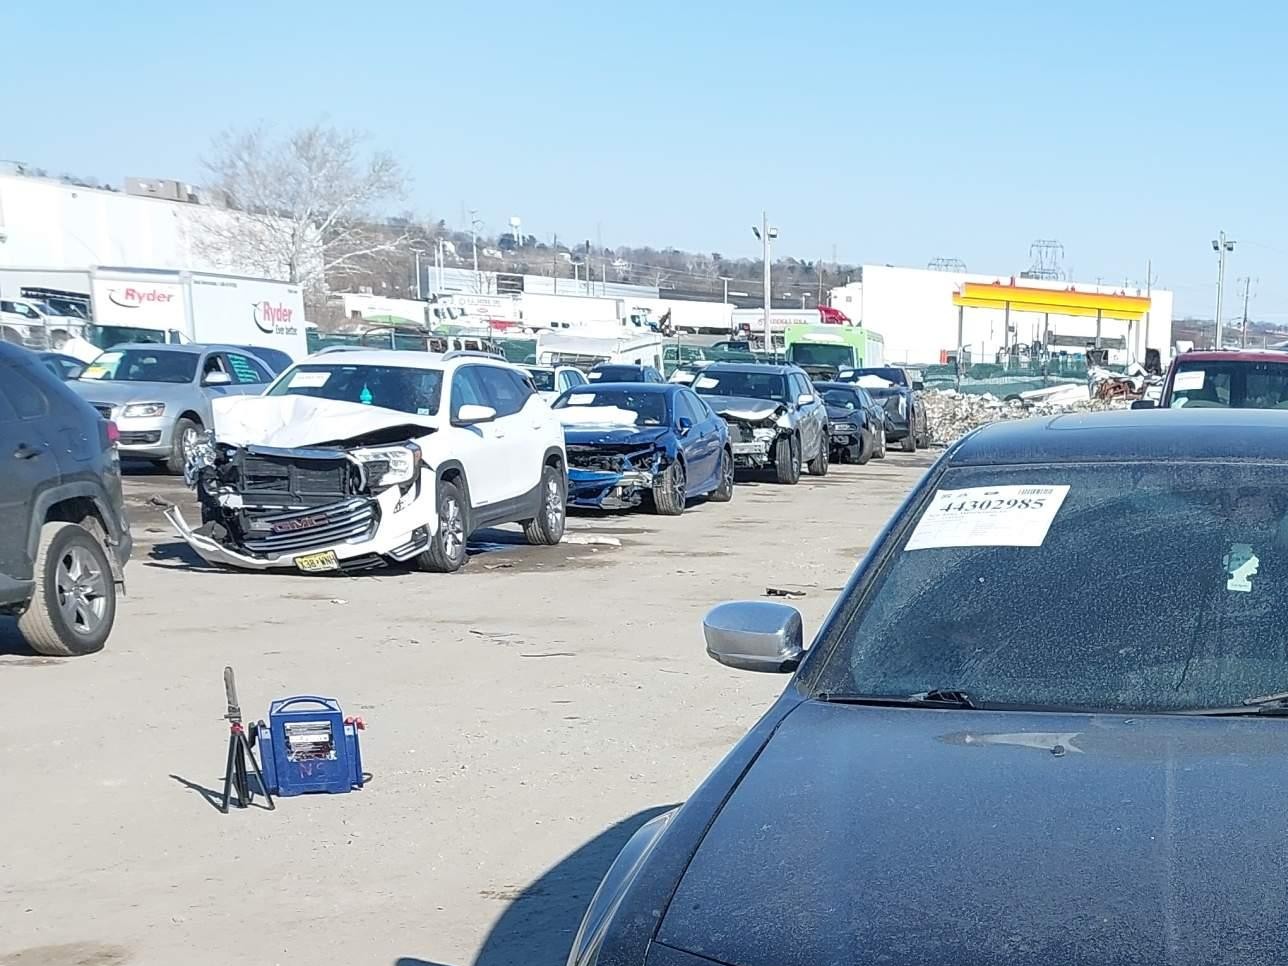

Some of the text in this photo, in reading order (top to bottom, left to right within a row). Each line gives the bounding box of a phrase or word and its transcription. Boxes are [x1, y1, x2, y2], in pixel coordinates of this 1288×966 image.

[125, 287, 174, 303] Ryder
[263, 301, 293, 326] Ryder
[940, 498, 1047, 512] 44302985
[272, 513, 329, 533] GMC
